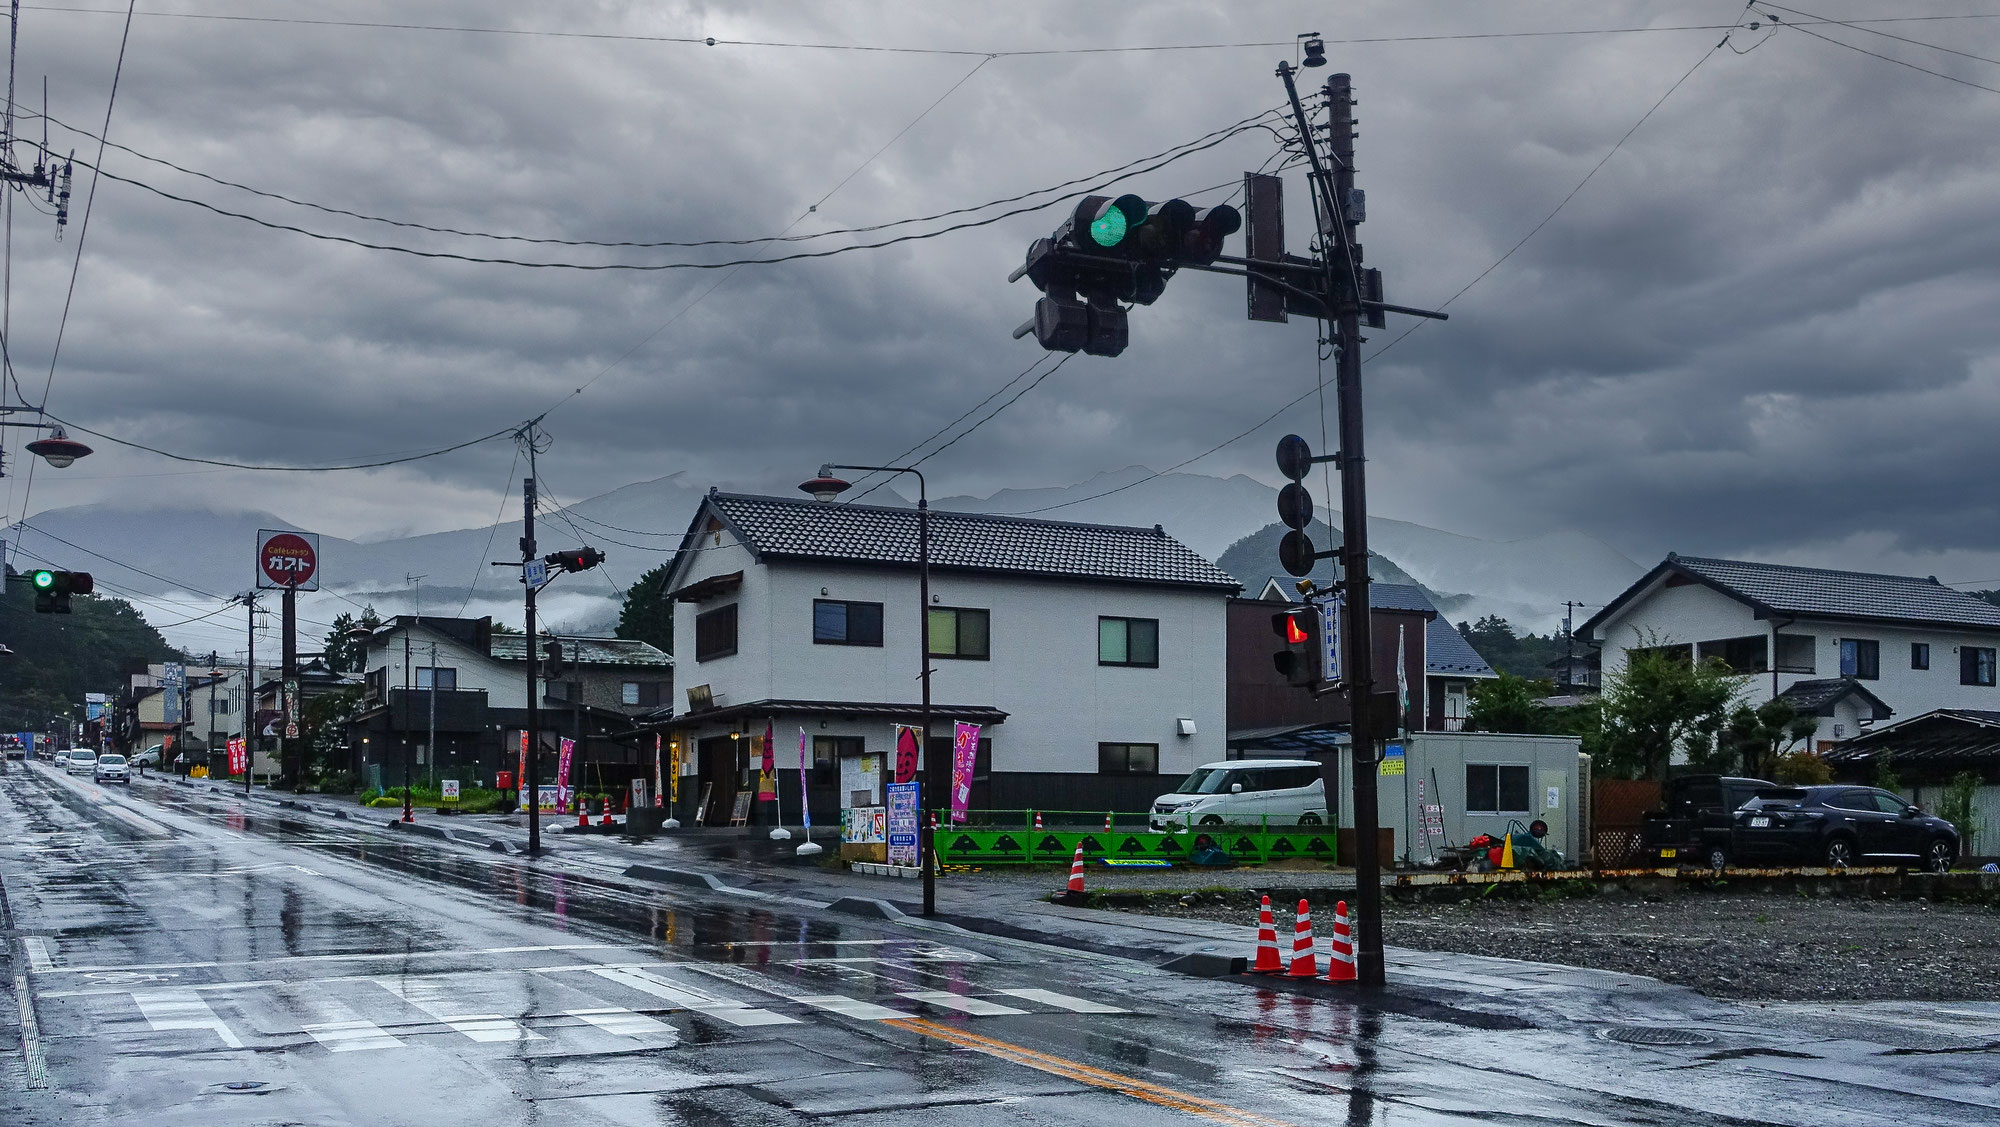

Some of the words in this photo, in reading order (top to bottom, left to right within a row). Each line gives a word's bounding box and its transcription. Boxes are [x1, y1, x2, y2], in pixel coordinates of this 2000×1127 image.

[269, 555, 311, 571] ガスト
[953, 731, 971, 789] かき氷
